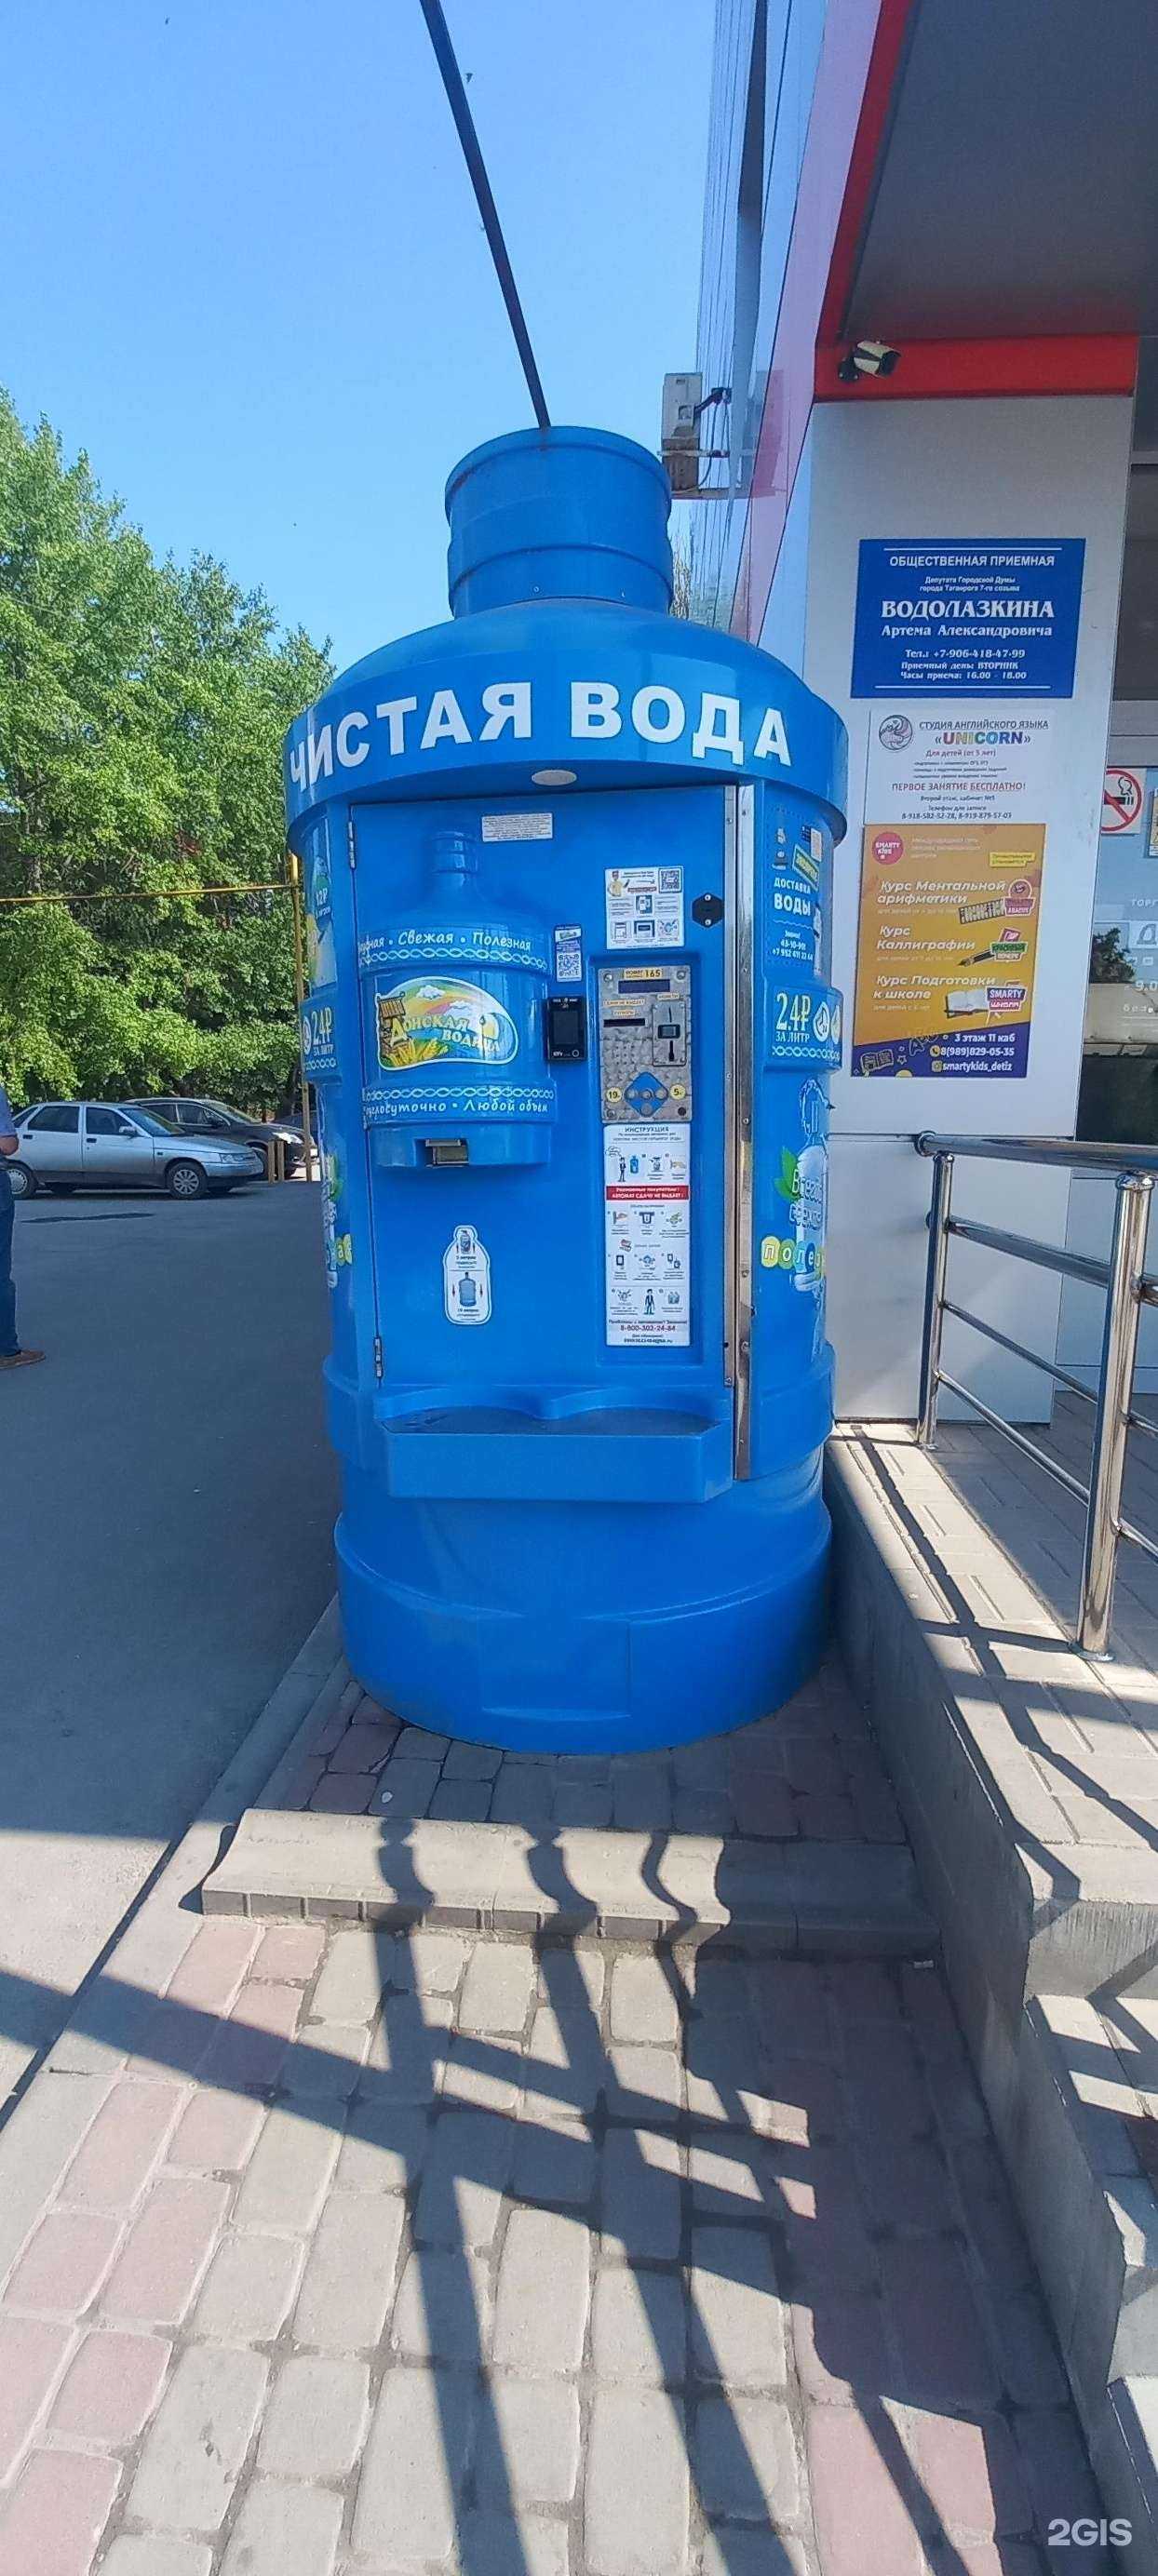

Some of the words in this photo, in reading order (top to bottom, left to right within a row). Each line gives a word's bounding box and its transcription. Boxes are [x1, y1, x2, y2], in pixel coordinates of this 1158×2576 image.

[890, 556, 987, 568] ОБЩЕСТВЕННАЯ
[990, 556, 1055, 567] ПРИЕМНАЯ
[925, 576, 957, 584] Депутата
[958, 575, 994, 584] Городской
[994, 576, 1016, 584] Думы
[881, 599, 1055, 622] ВОДОЛАЗКИНА
[882, 625, 931, 638] Артема
[937, 624, 1052, 639] Александровича
[933, 649, 1026, 659] +7-906-418-47-99
[901, 662, 948, 670] Приемный
[977, 662, 1018, 670] ВТОРНИК
[901, 671, 923, 679] Часы
[927, 672, 963, 680] приема:
[919, 720, 951, 731] СТУДИЯ
[954, 718, 1017, 731] АНГЛИЙСКОГО
[1018, 720, 1048, 730] ЯЗЫКА
[290, 681, 532, 794] ЧИСТАЯ
[570, 680, 792, 767] ВОДА
[935, 731, 1030, 745] «UNICORN»
[941, 749, 963, 758] детей
[929, 783, 968, 791] ЗАНЯТИЕ
[970, 782, 1026, 791] БЕСПЛАТНО!
[774, 877, 812, 895] ДОСТАВКА
[881, 881, 912, 892] Курс
[916, 880, 1005, 892] Ментальной
[774, 893, 811, 916] ВОДЫ
[880, 926, 910, 937] Курс
[397, 930, 454, 946] Свежая
[472, 932, 532, 953] Полезная
[877, 940, 976, 951] Каллиграфии
[644, 970, 661, 978] 165
[877, 975, 907, 986] Курс
[910, 975, 996, 986] Подготовки
[873, 990, 881, 999] к
[884, 990, 932, 1000] школе
[990, 988, 1022, 998] SMARTY
[775, 1031, 786, 1040] ЗА
[788, 1031, 810, 1042] ЛИТР
[954, 1033, 961, 1042] 3
[963, 1034, 986, 1042] этаж
[998, 1033, 1016, 1042] каб
[940, 1046, 1015, 1057] 8(989)829-05-35
[943, 1061, 1013, 1072] smartykids_detiz
[464, 1099, 516, 1112] Любой
